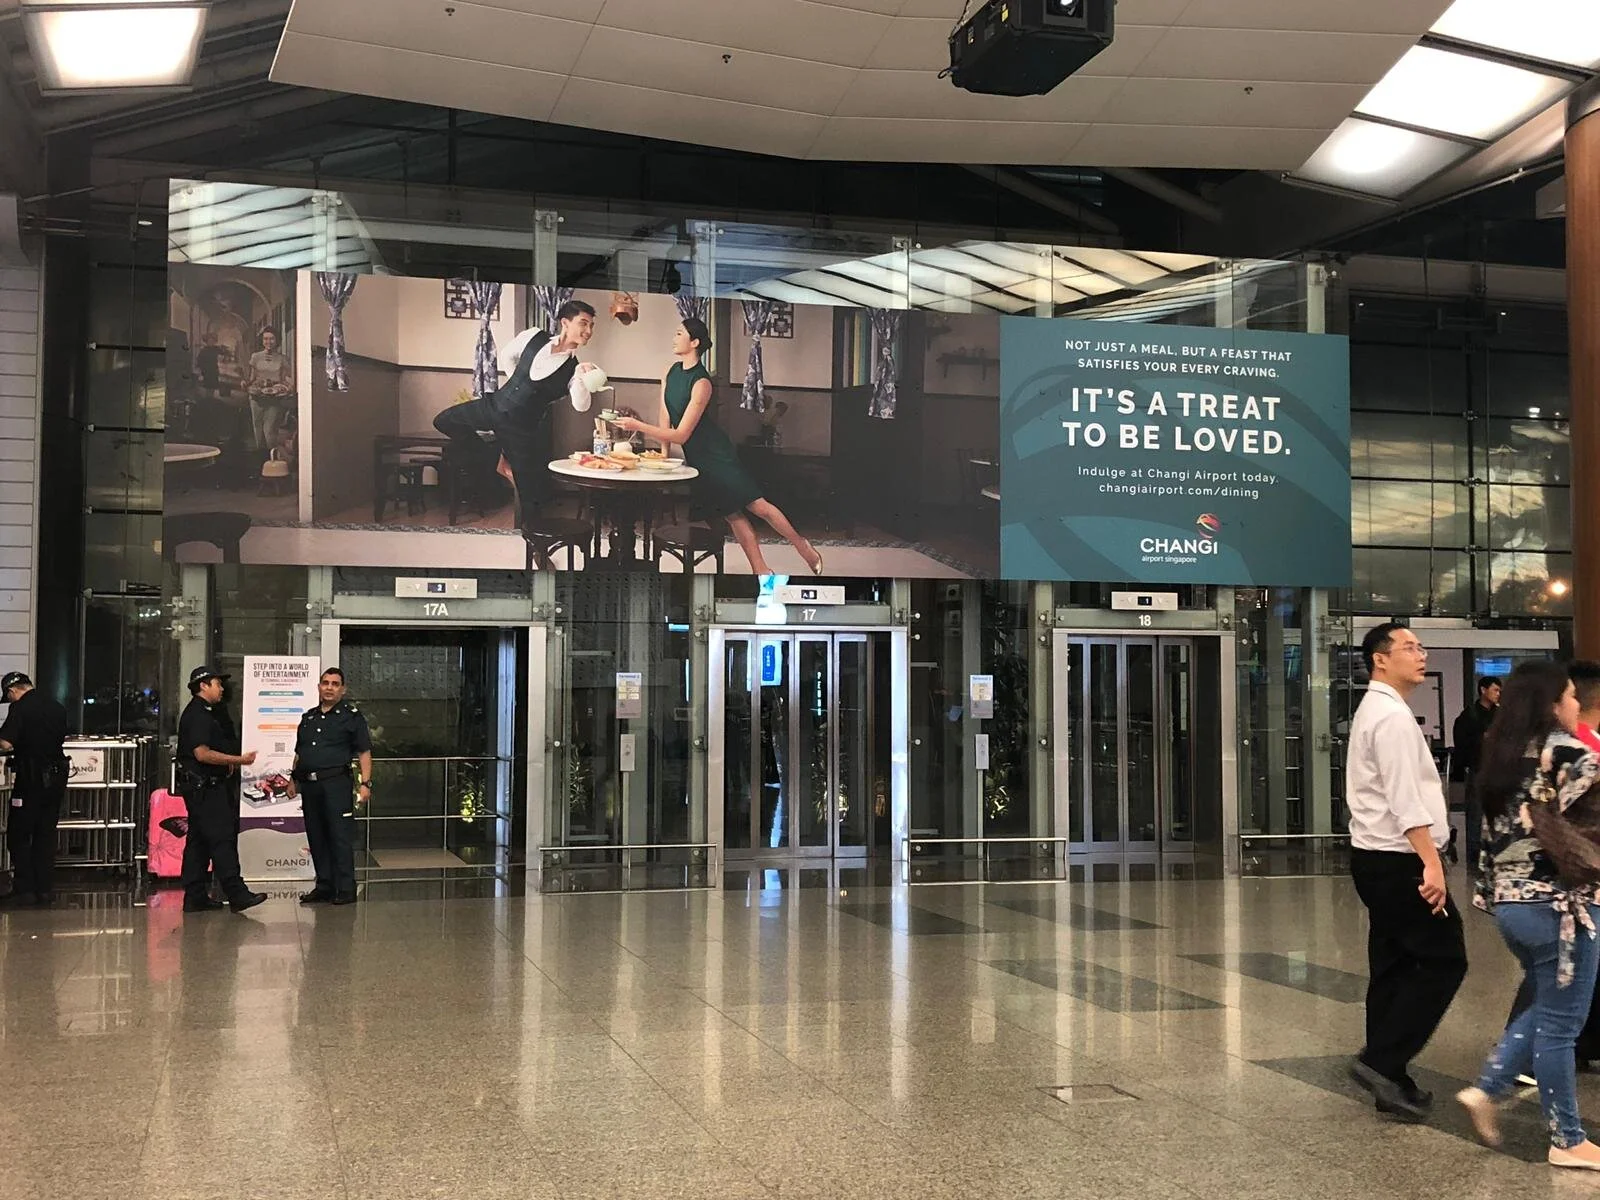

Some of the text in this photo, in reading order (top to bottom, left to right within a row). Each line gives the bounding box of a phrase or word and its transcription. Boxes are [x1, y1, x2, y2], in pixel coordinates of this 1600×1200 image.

[1065, 340, 1091, 350] NOT
[1094, 341, 1126, 352] JUST
[1129, 344, 1138, 353] A
[1181, 346, 1206, 357] BUT
[1209, 348, 1218, 357] A
[1221, 348, 1258, 360] FEAST
[1261, 351, 1292, 361] THAT
[1078, 358, 1280, 378] SATISFIES YOUR EVERY CRAVING.
[1072, 387, 1281, 421] IT'S A TREAT
[1062, 421, 1291, 456] TO BE LOVED.
[1078, 466, 1279, 485] Indulge at Changi Airport today.
[1099, 483, 1259, 500] changiairport.com/dining
[1140, 537, 1218, 555] CHANGI
[1142, 555, 1198, 565] airport singapore
[423, 602, 449, 617] 17A
[802, 608, 817, 621] 17
[1138, 614, 1152, 627] 18
[253, 662, 267, 670] STEP
[269, 662, 282, 670] INTO
[289, 663, 309, 671] WORLD
[253, 670, 310, 678] OF ENTERTAINMENT
[265, 858, 310, 867] CHANGI
